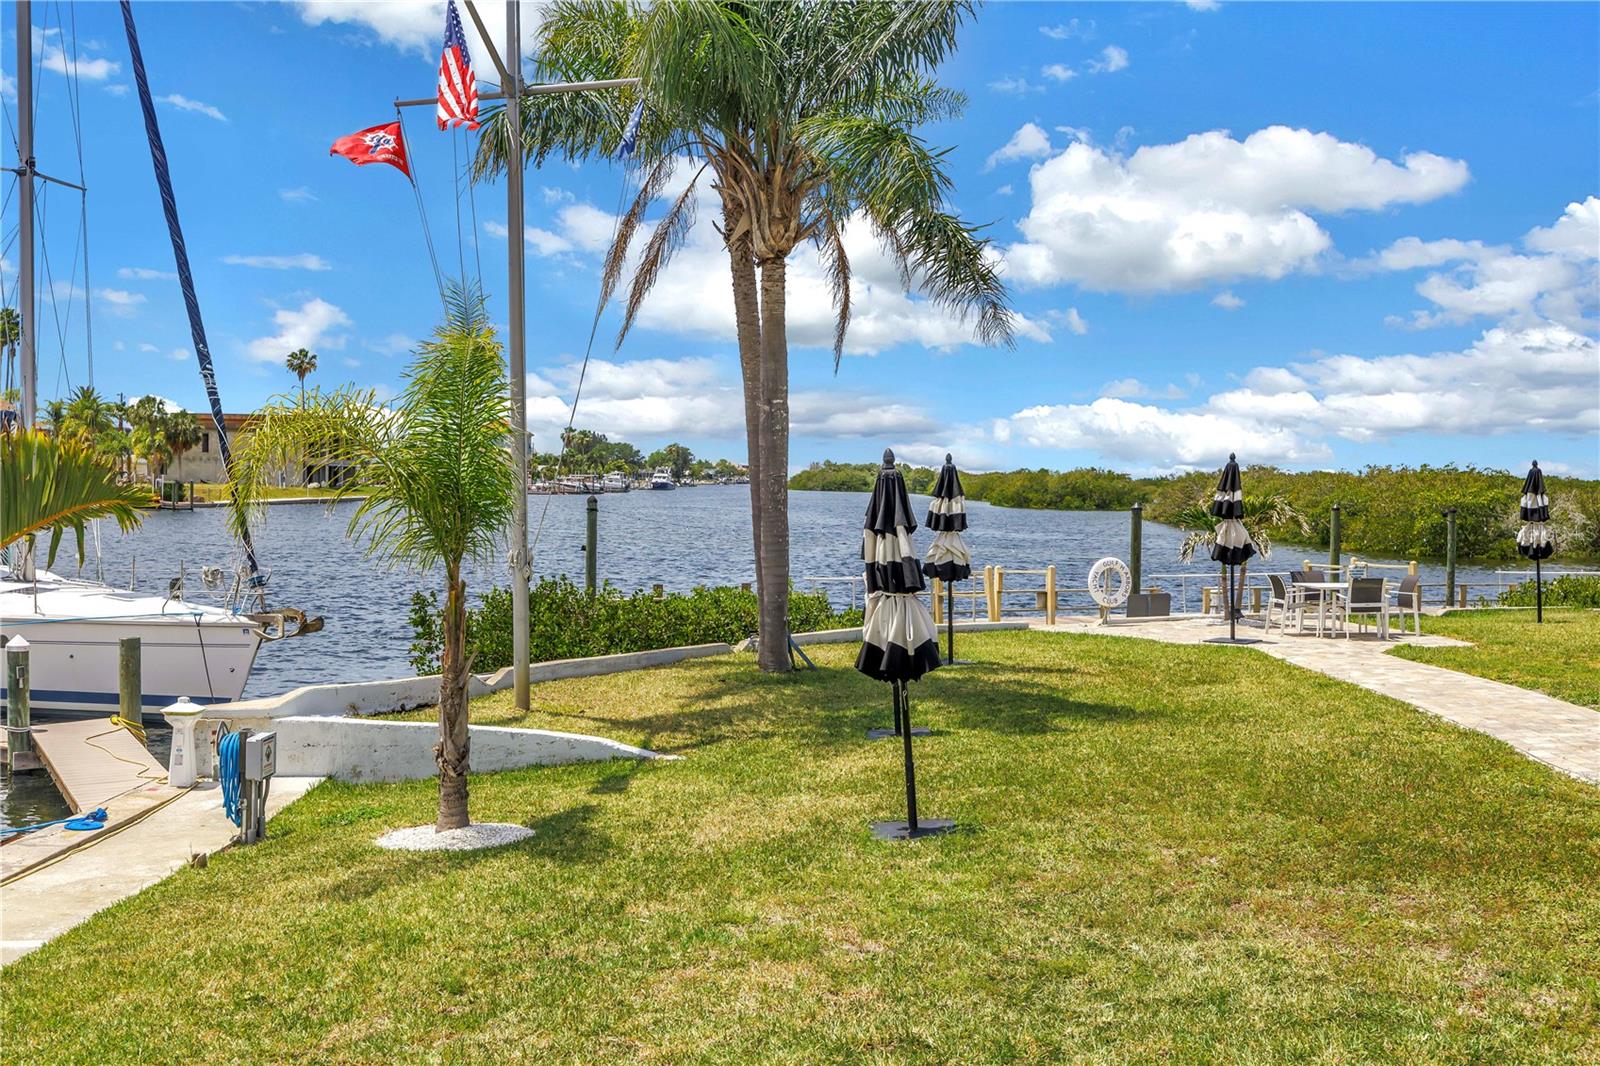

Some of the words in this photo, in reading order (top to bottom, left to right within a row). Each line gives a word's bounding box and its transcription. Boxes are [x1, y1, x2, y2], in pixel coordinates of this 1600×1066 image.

[1091, 570, 1100, 593] YACHT
[1102, 596, 1118, 605] CLUB
[1102, 560, 1119, 568] GULF
[1119, 565, 1131, 598] HARBORS
